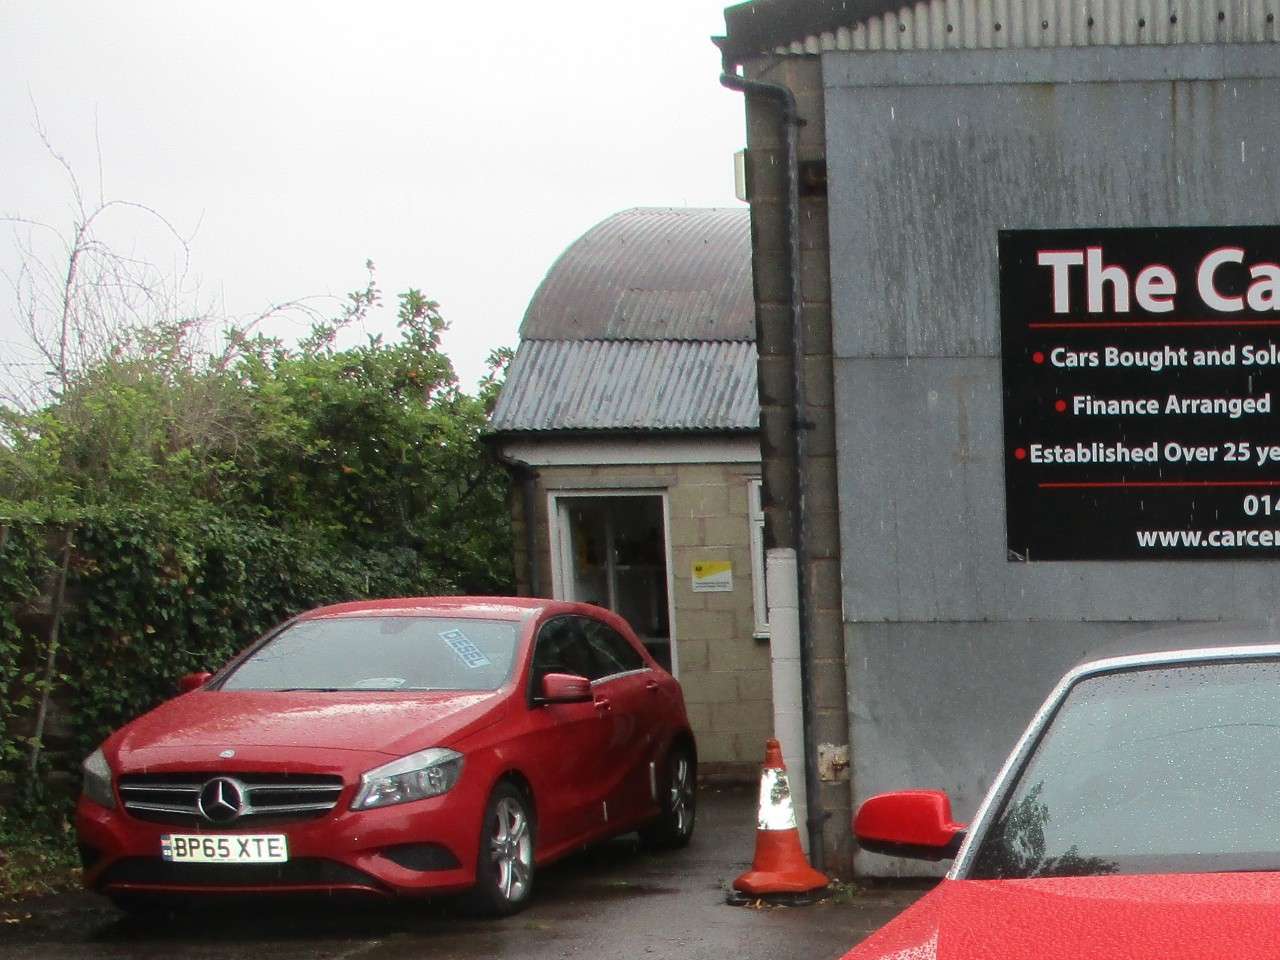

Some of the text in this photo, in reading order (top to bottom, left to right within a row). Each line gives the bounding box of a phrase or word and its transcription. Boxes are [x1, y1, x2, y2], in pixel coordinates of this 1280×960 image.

[1037, 247, 1176, 313] The
[1050, 347, 1098, 367] Cars
[1105, 346, 1188, 371] Bought
[1193, 346, 1235, 366] and
[1073, 393, 1271, 418] Finance Arranged
[1030, 442, 1158, 463] Established
[1164, 443, 1218, 462] Over
[1223, 443, 1250, 461] 25
[174, 837, 281, 858] BP65 XTE
